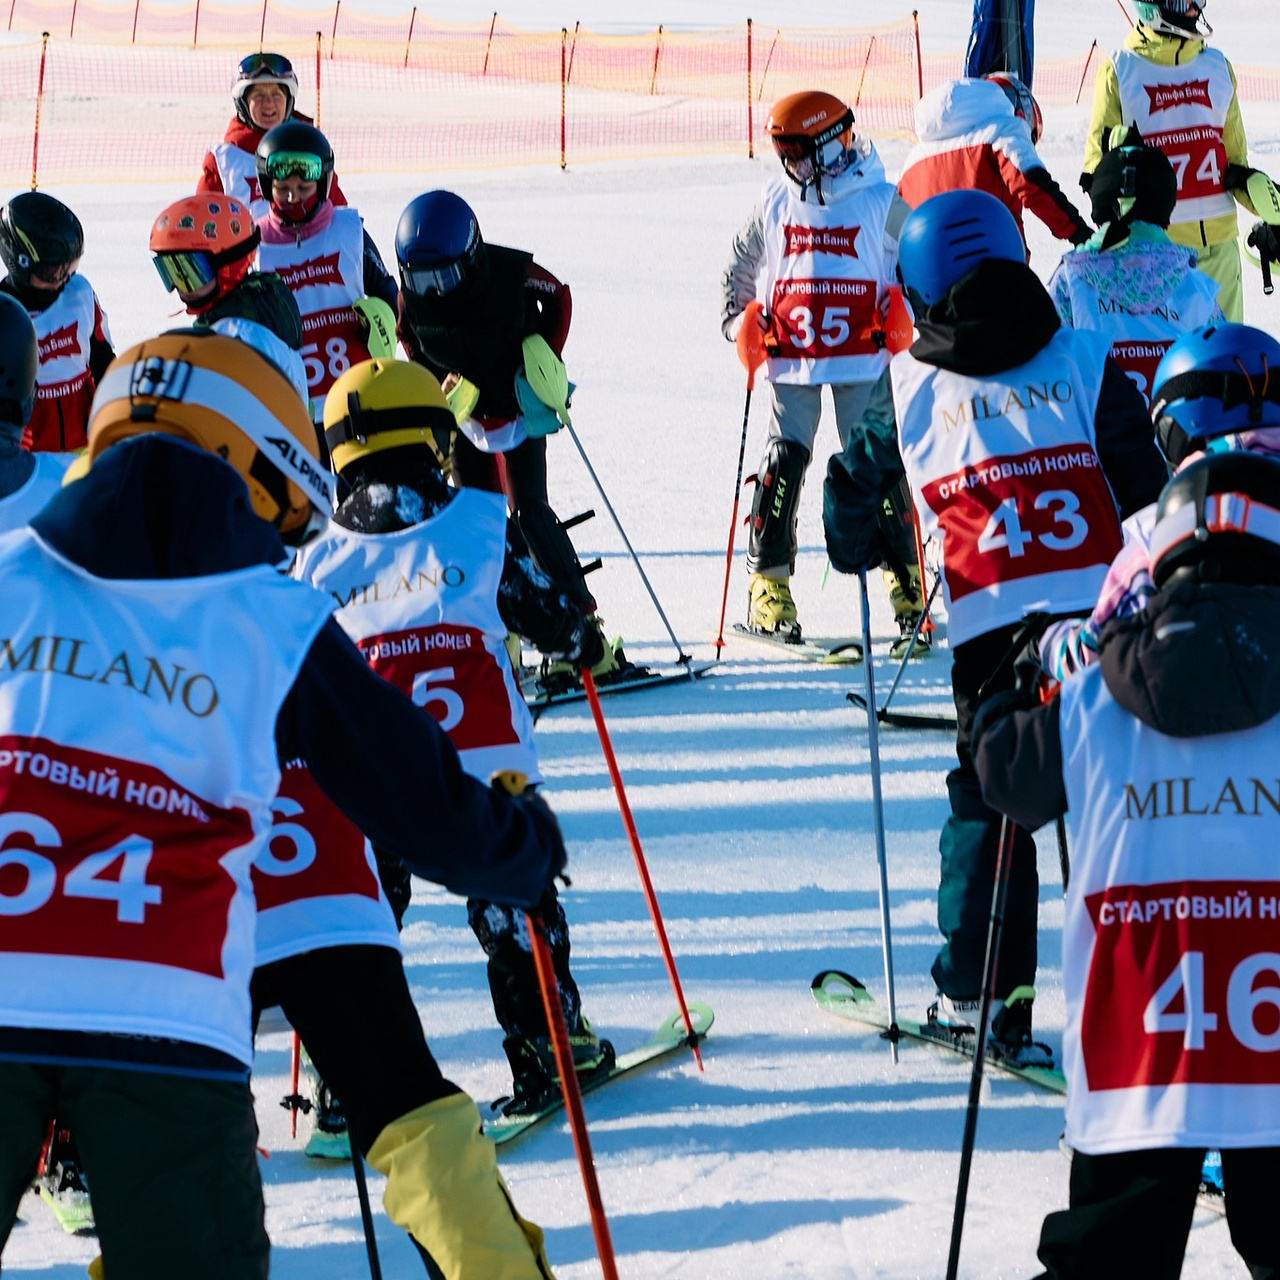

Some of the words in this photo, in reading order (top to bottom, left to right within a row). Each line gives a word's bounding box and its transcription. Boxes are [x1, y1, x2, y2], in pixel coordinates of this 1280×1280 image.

[1155, 87, 1184, 105] Альфа
[1185, 85, 1206, 98] Банк
[814, 122, 845, 147] HEAD
[1168, 148, 1221, 191] 74
[790, 233, 821, 251] Альфа
[823, 232, 850, 247] Банк
[282, 270, 306, 287] льфа
[307, 264, 335, 278] Банк
[776, 280, 830, 296] СТАРТОВЫЙ
[833, 282, 867, 296] НОМЕР
[50, 336, 74, 354] Банк
[373, 313, 390, 347] LEKI
[789, 306, 850, 349] 35
[303, 336, 351, 387] 58
[1110, 343, 1166, 360] РТОВЫЙ
[942, 379, 1072, 433] MILANO
[264, 434, 333, 507] ALPINA
[938, 456, 1042, 500] СТАРТОВЫЙ
[1045, 451, 1099, 471] НОМЕР
[772, 476, 788, 519] LEKI
[978, 489, 1089, 558] 43
[332, 564, 466, 609] MILANO
[361, 634, 421, 662] ТОВЫЙ
[0, 636, 219, 718] MILANO
[0, 811, 162, 924] 64
[1099, 890, 1253, 926] СТАРТОВЫЙ
